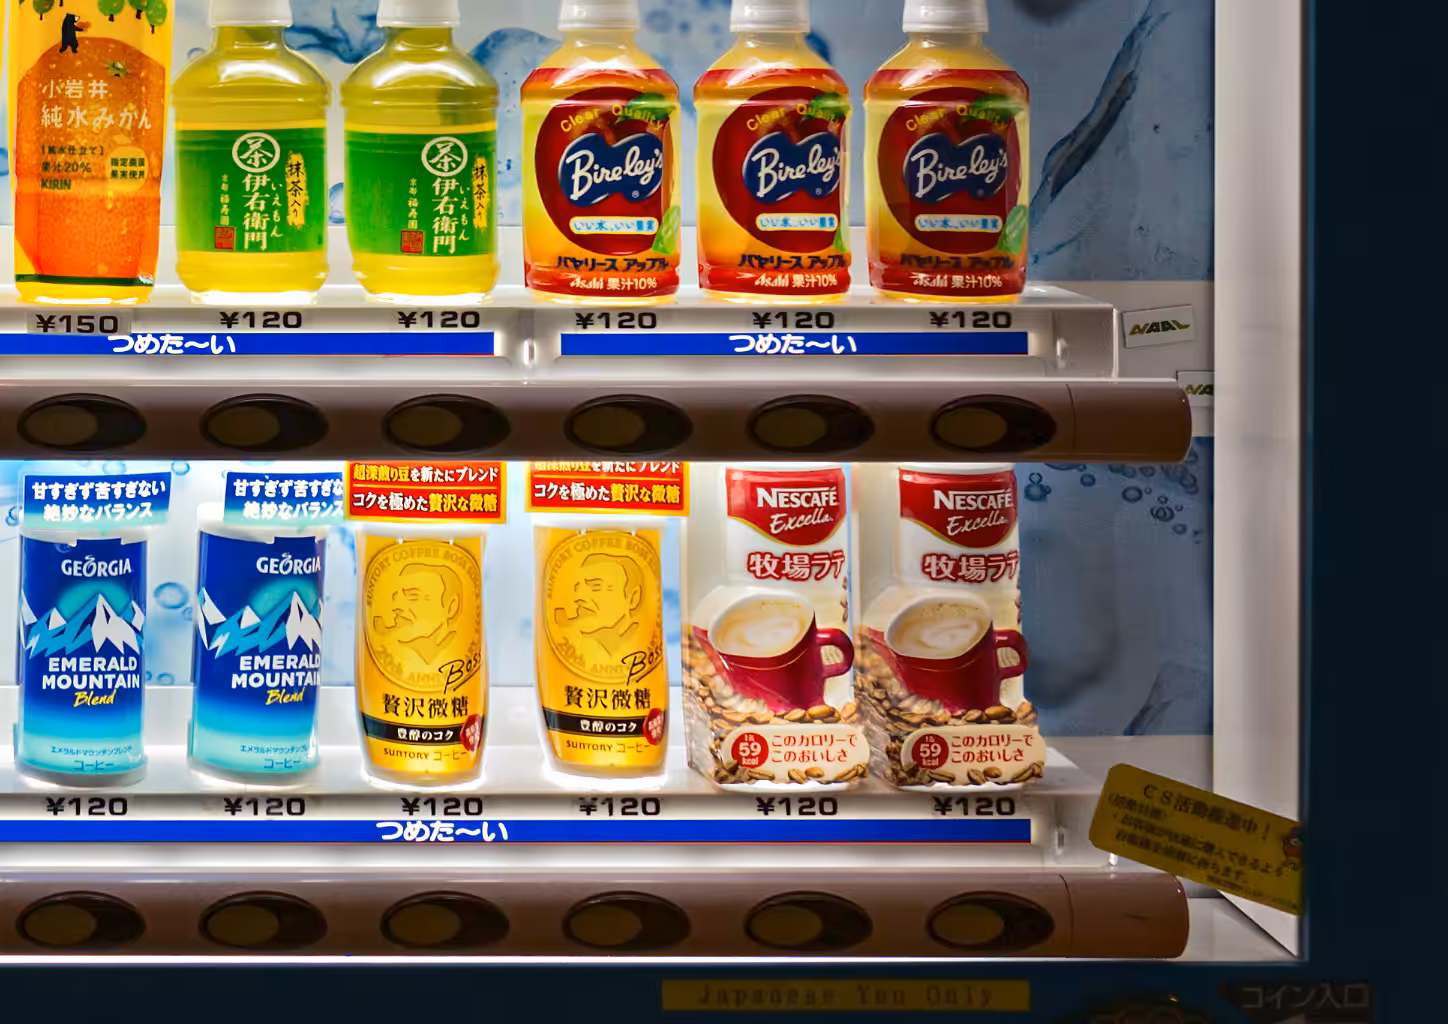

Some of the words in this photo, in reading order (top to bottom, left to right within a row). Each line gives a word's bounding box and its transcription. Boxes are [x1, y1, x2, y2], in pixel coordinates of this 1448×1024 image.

[560, 107, 600, 132] Clear
[240, 138, 273, 167] 茶
[429, 142, 461, 169] 茶
[242, 174, 271, 251] 伊右衛門
[432, 178, 460, 255] 伊右衛門
[36, 314, 119, 333] ¥150
[220, 311, 302, 328] ¥120
[398, 311, 480, 328] ¥120
[575, 312, 657, 329] ¥120
[753, 311, 835, 328] ¥120
[930, 311, 1012, 328] ¥120
[770, 507, 833, 535] Excella
[61, 555, 133, 578] GEORGIA
[256, 553, 321, 576] GEORGIA
[48, 655, 138, 673] EMERALD
[239, 654, 320, 672] EMERALD
[42, 672, 140, 690] MOUNTAIN
[73, 688, 117, 707] Blend
[265, 687, 305, 705] Blend
[382, 693, 469, 718] 贅沢微糖
[564, 685, 651, 710] 贅沢微糖
[739, 742, 761, 757] 59
[772, 733, 857, 747] このカロリーで
[772, 749, 848, 763] このおいしさ
[46, 797, 128, 816] ¥120
[224, 797, 306, 816] ¥120
[401, 797, 483, 816] ¥120
[580, 797, 660, 816] ¥120
[757, 797, 838, 815] ¥120
[935, 797, 1016, 816] ¥120
[1241, 982, 1369, 1009] コイン入口
